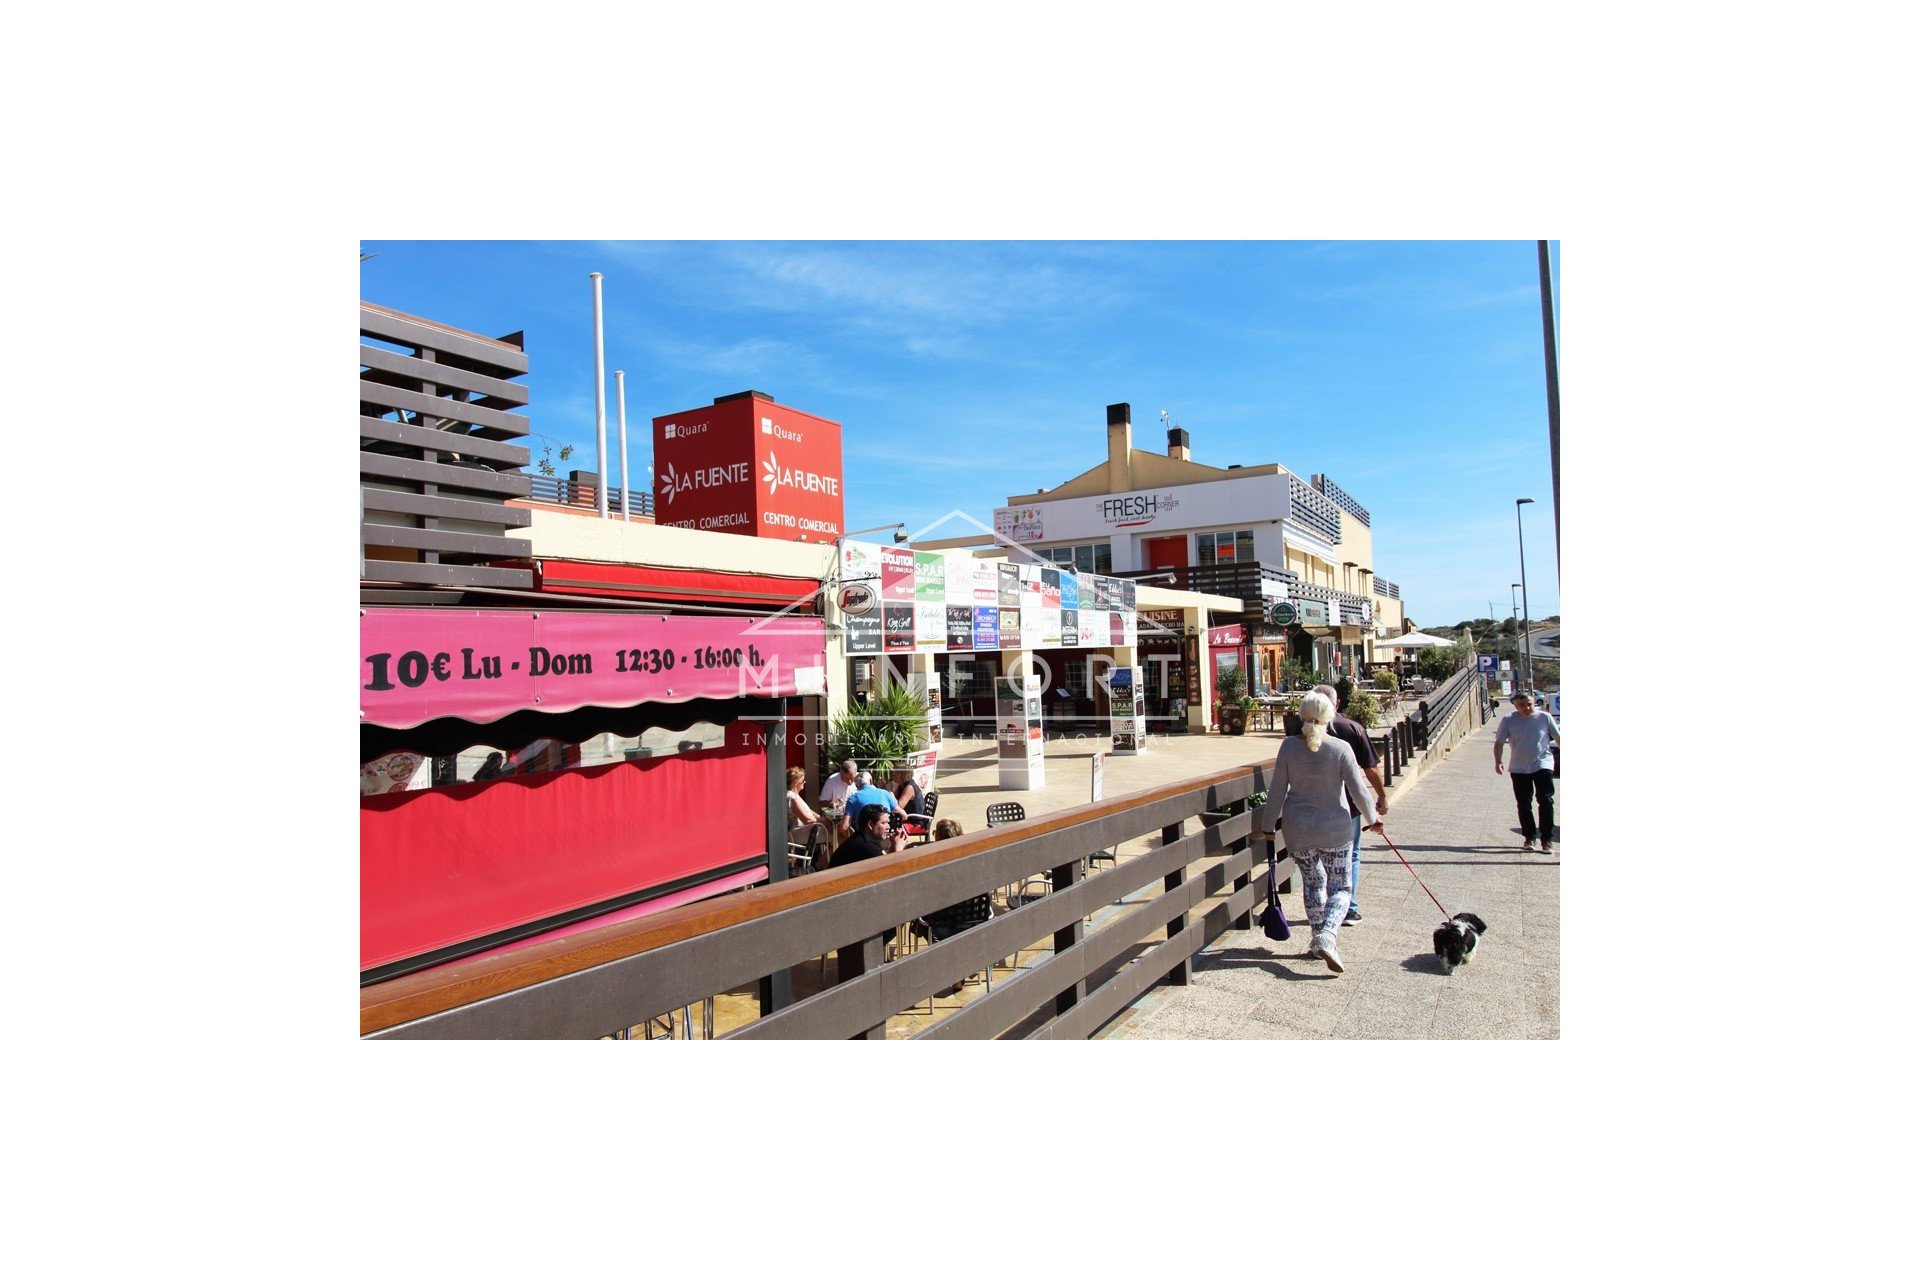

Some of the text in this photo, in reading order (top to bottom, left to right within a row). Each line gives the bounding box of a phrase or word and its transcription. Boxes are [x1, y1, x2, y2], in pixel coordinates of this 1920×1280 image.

[676, 423, 708, 438] Quara
[773, 426, 802, 443] Quara
[675, 462, 749, 492] LA FUENTE
[777, 465, 838, 497] LA FUENTE
[1104, 494, 1157, 519] FRESH
[699, 512, 750, 530] COMERCIAL
[763, 511, 839, 535] CENTRO COMERCIAL
[846, 614, 880, 627] Champagne
[1137, 610, 1179, 621] CUISINE
[852, 642, 865, 650] Upper
[363, 649, 451, 690] 10€
[460, 647, 502, 679] Lu
[528, 646, 592, 677] Dom
[614, 648, 675, 674] 12:30
[693, 647, 743, 670] 16:00
[748, 644, 766, 668] h.
[1479, 656, 1492, 671] P
